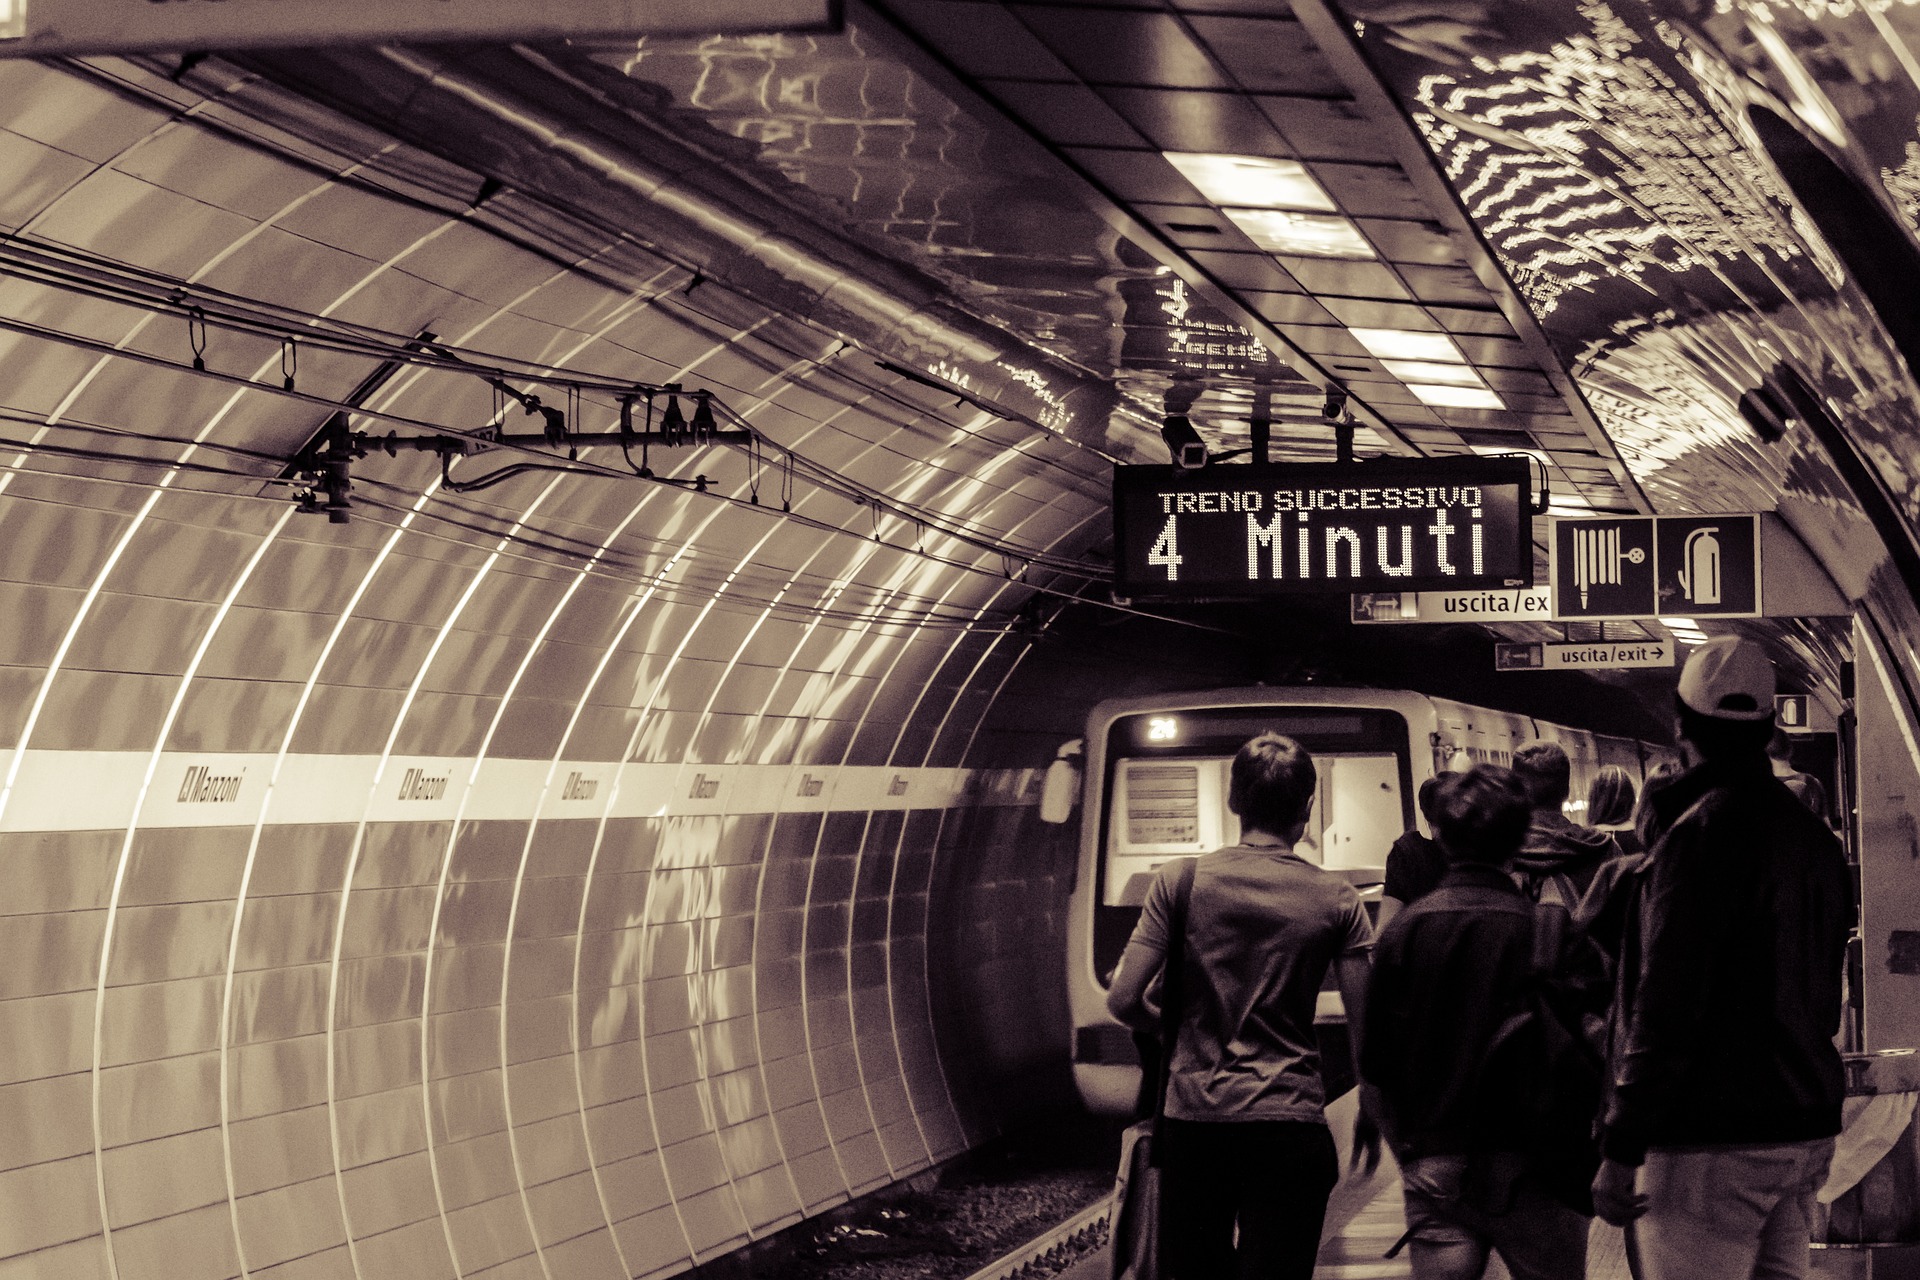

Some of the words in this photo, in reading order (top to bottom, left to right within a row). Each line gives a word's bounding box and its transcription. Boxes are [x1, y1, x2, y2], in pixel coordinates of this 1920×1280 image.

[1158, 491, 1262, 513] TRENO
[1274, 486, 1481, 511] SUCCESSIVO
[1148, 514, 1183, 581] 4
[1247, 508, 1483, 579] Minuti
[1444, 590, 1549, 613] uscita/ex
[1561, 645, 1648, 663] uscita/exit
[189, 766, 247, 803] Manzoni
